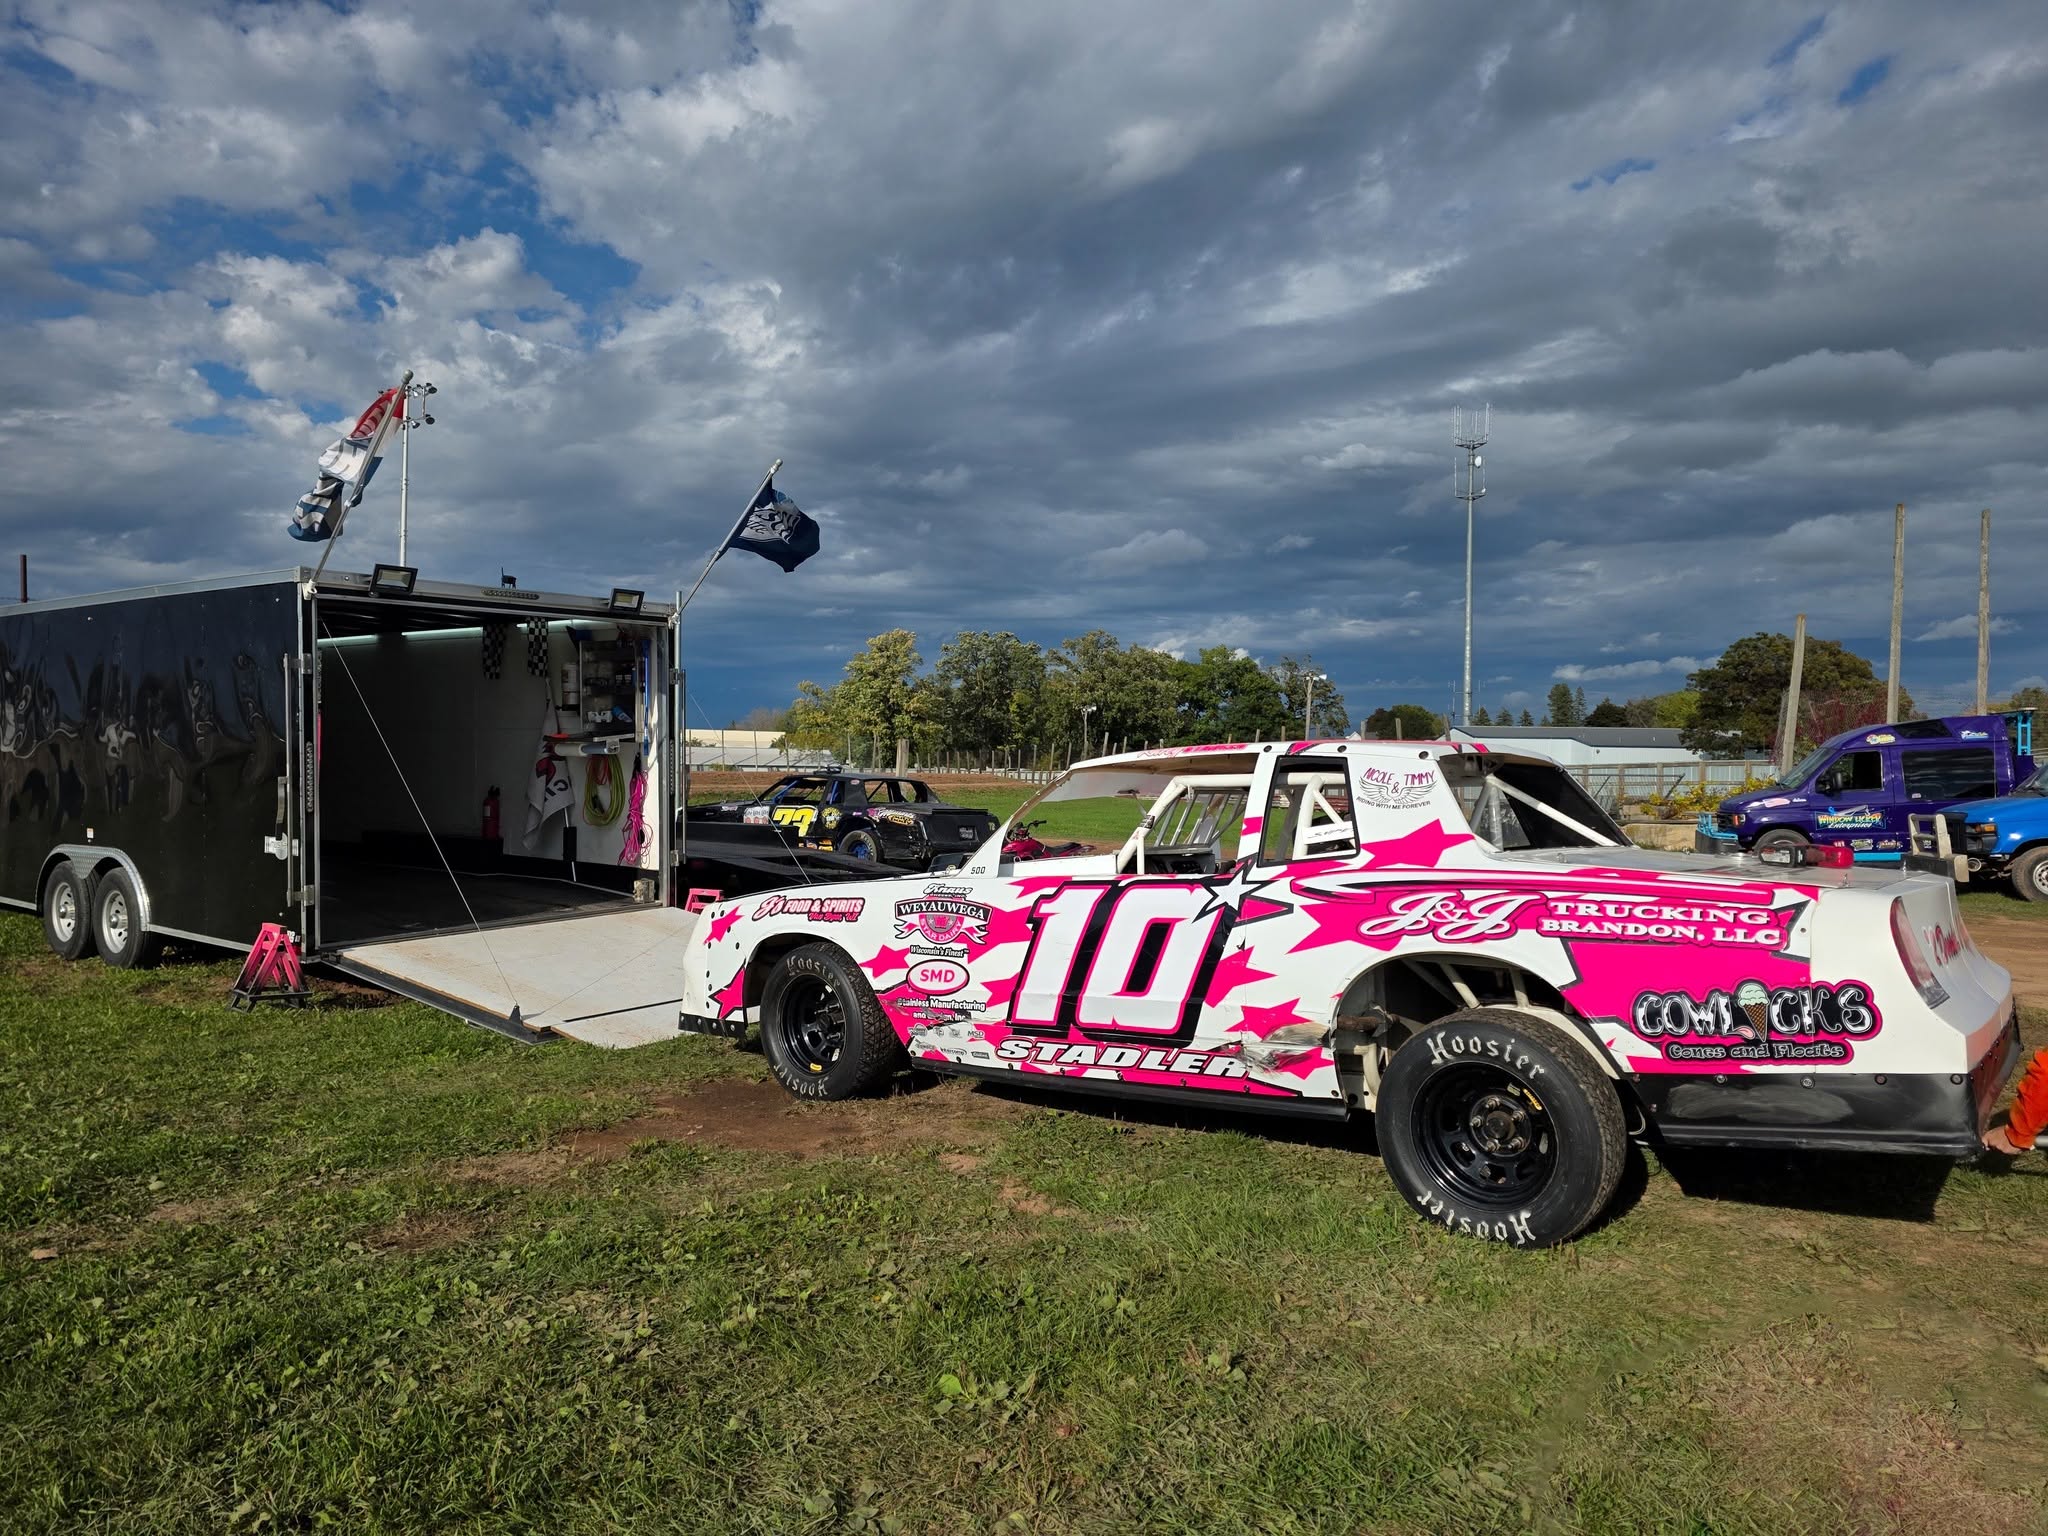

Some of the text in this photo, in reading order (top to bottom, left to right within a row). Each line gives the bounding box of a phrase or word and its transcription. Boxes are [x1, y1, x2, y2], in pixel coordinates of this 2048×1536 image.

[1391, 782, 1399, 794] &
[1404, 771, 1434, 786] TIMMY
[1356, 796, 1375, 806] RIDING
[1401, 800, 1431, 810] FOREVER
[1818, 814, 1853, 824] WINDOW
[971, 866, 986, 875] 500
[923, 883, 973, 895] Knaus
[783, 899, 812, 912] FOOD
[811, 899, 821, 912] &
[822, 899, 864, 913] SPIRITS
[899, 902, 985, 919] WEYAUWEGA
[1360, 892, 1771, 940] J&J TRUCKING
[920, 918, 962, 941] STAR DAIRY
[1541, 919, 1780, 945] BRANDON, LLC
[911, 945, 943, 956] Wisconsin's
[1011, 882, 1225, 1036] 10
[920, 969, 955, 983] SMD
[930, 1000, 986, 1011] Manufacturing
[999, 1038, 1250, 1077] STADLER
[1426, 1031, 1545, 1080] Hoosier
[1669, 1043, 1844, 1058] Cones and Floats
[1416, 1190, 1537, 1249] Hoosier
